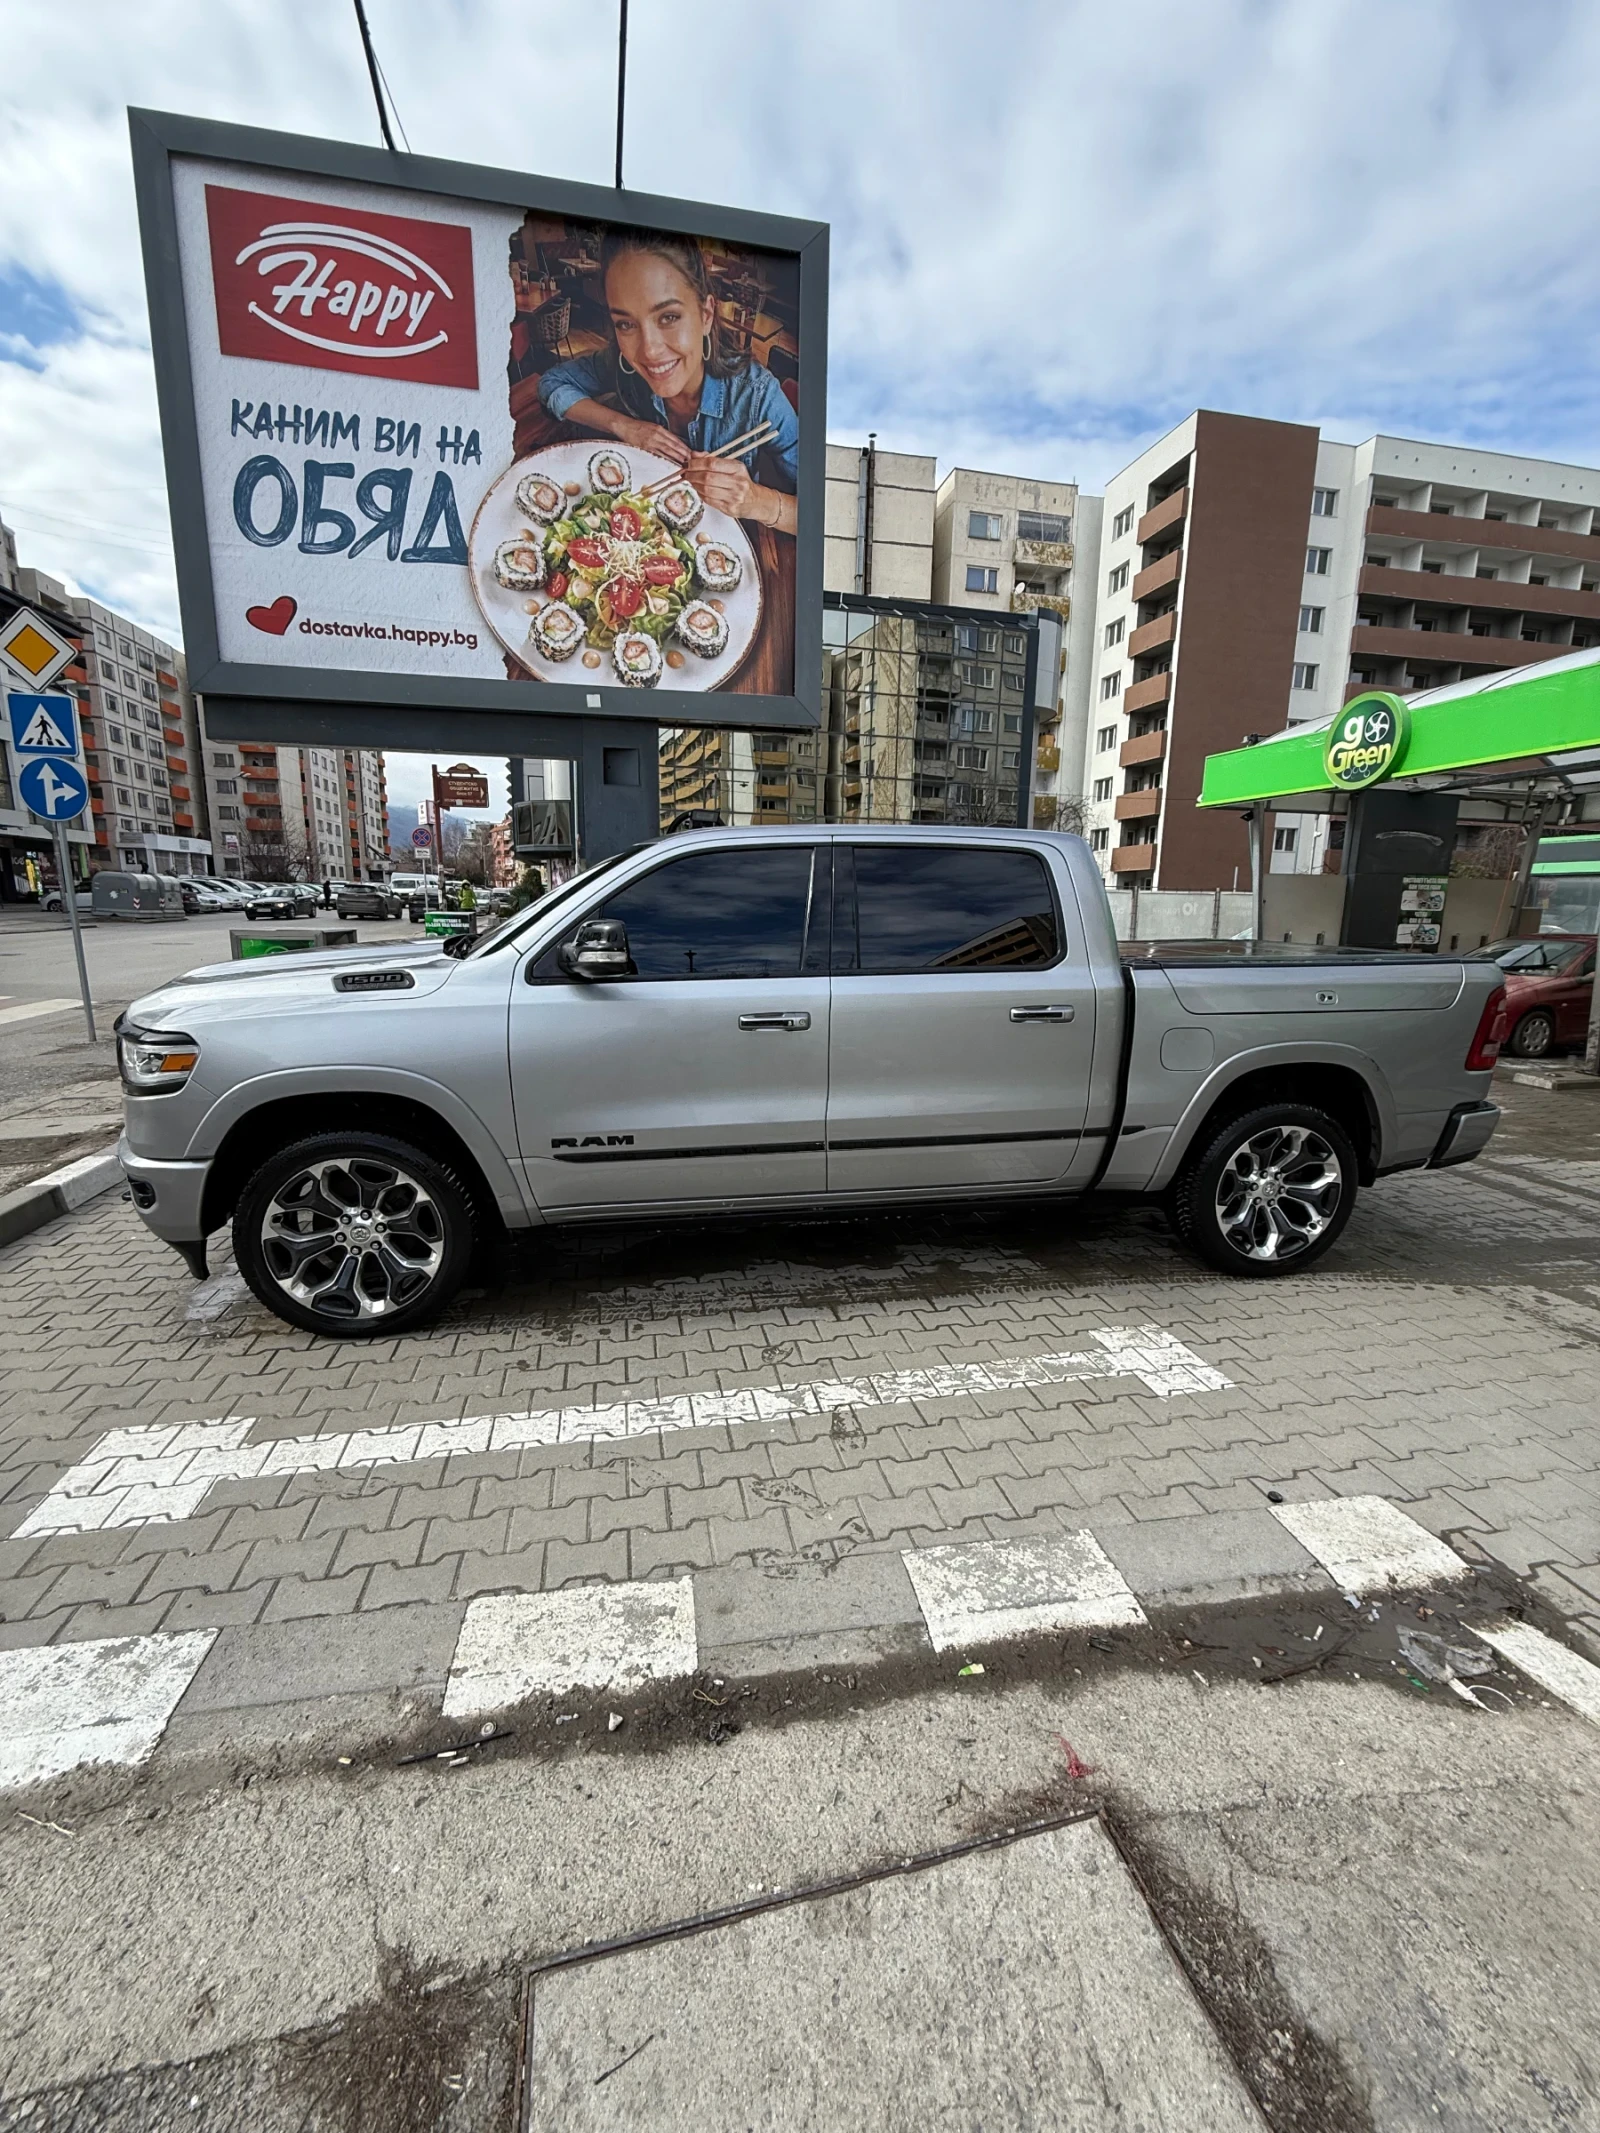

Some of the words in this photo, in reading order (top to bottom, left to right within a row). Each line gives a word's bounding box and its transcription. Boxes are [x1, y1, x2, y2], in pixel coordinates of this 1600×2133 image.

[258, 251, 435, 337] Happy
[231, 398, 360, 451] КАНИМ
[374, 416, 421, 459] ВИ
[436, 425, 483, 466] НА
[233, 454, 469, 566] ОБЯД
[299, 618, 478, 650] dostavka.happy.bg
[1328, 742, 1391, 774] Green
[347, 974, 402, 984] 1500
[551, 1135, 634, 1148] RAM
